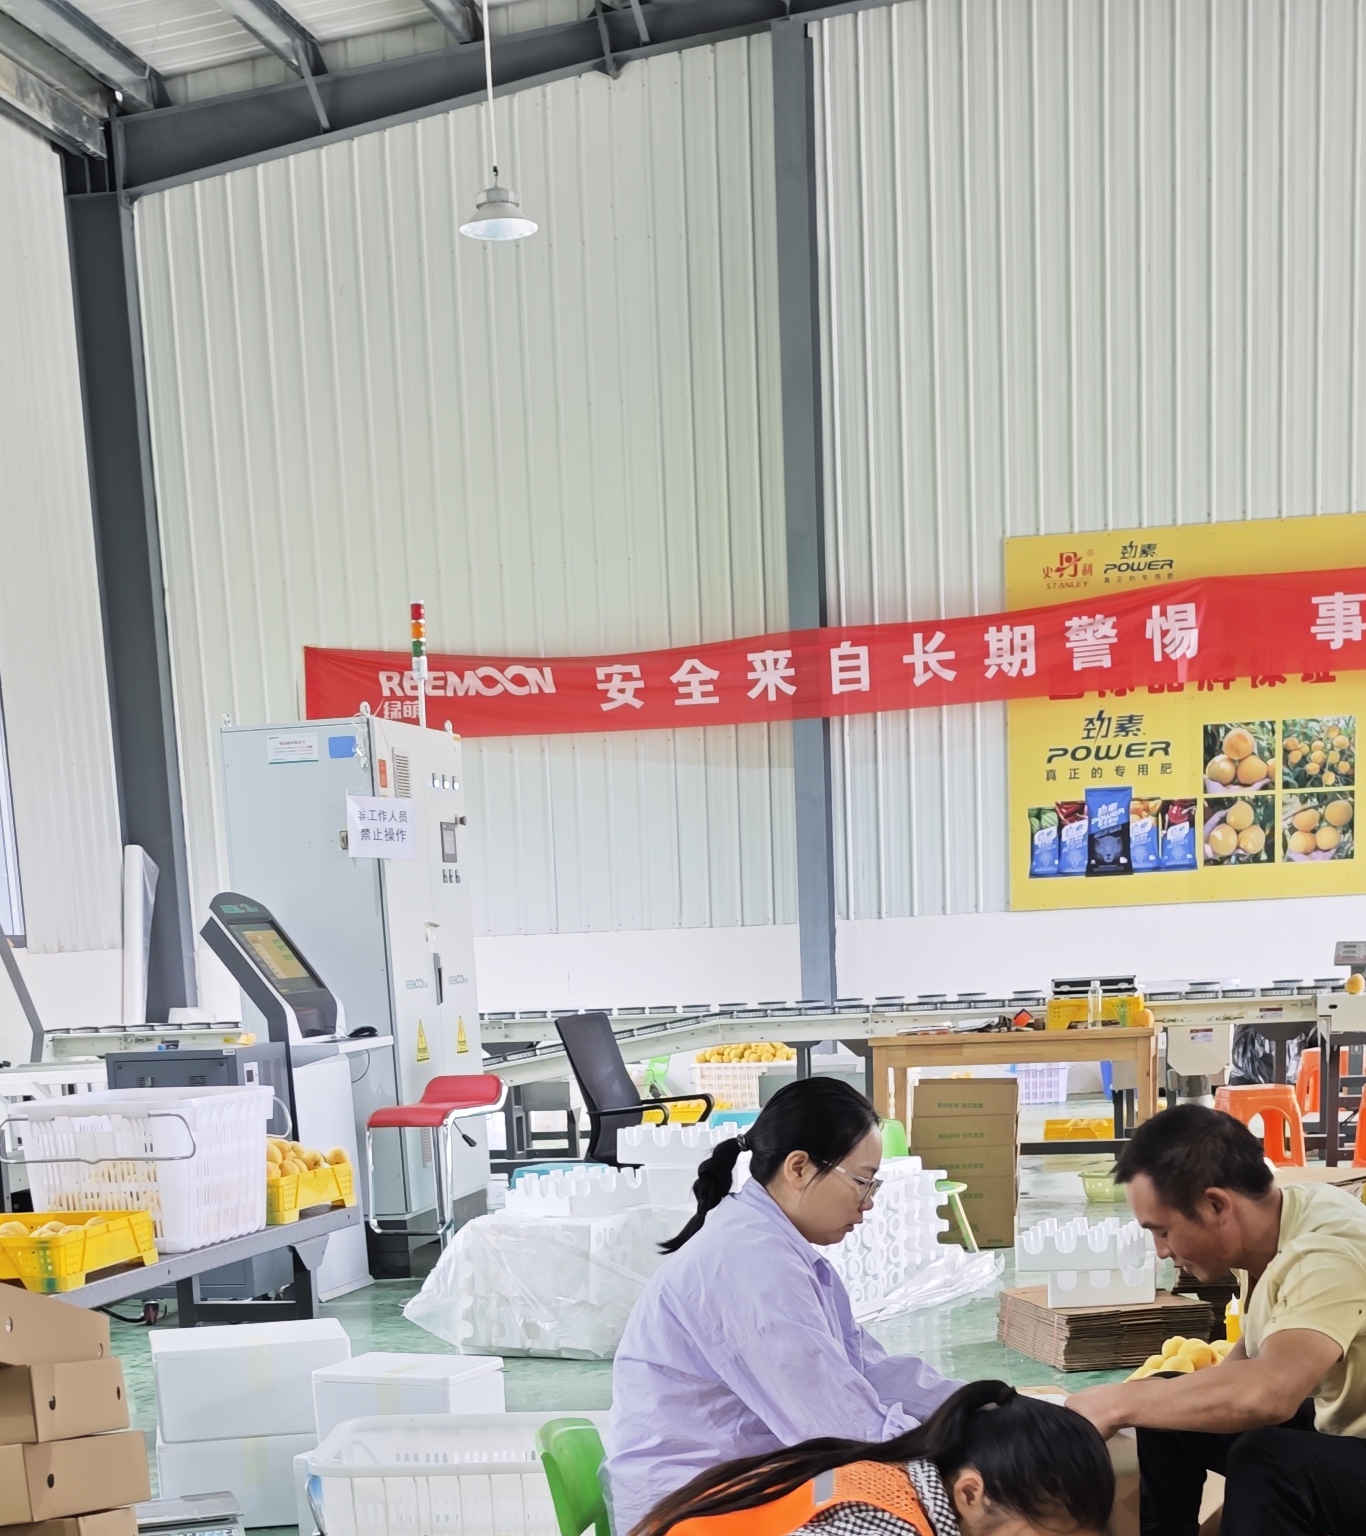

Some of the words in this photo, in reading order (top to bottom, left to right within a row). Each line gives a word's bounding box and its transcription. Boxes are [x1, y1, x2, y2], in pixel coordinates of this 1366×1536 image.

[1103, 559, 1174, 574] POWER
[1046, 580, 1089, 590] STANLEY
[595, 601, 1200, 711] 安全来自长期警惕
[1081, 710, 1145, 744] 劲素
[1046, 741, 1172, 764] POWER
[1045, 763, 1173, 782] 真正的专用肥
[358, 809, 408, 824] 非工作人员
[360, 828, 407, 843] 禁止操作
